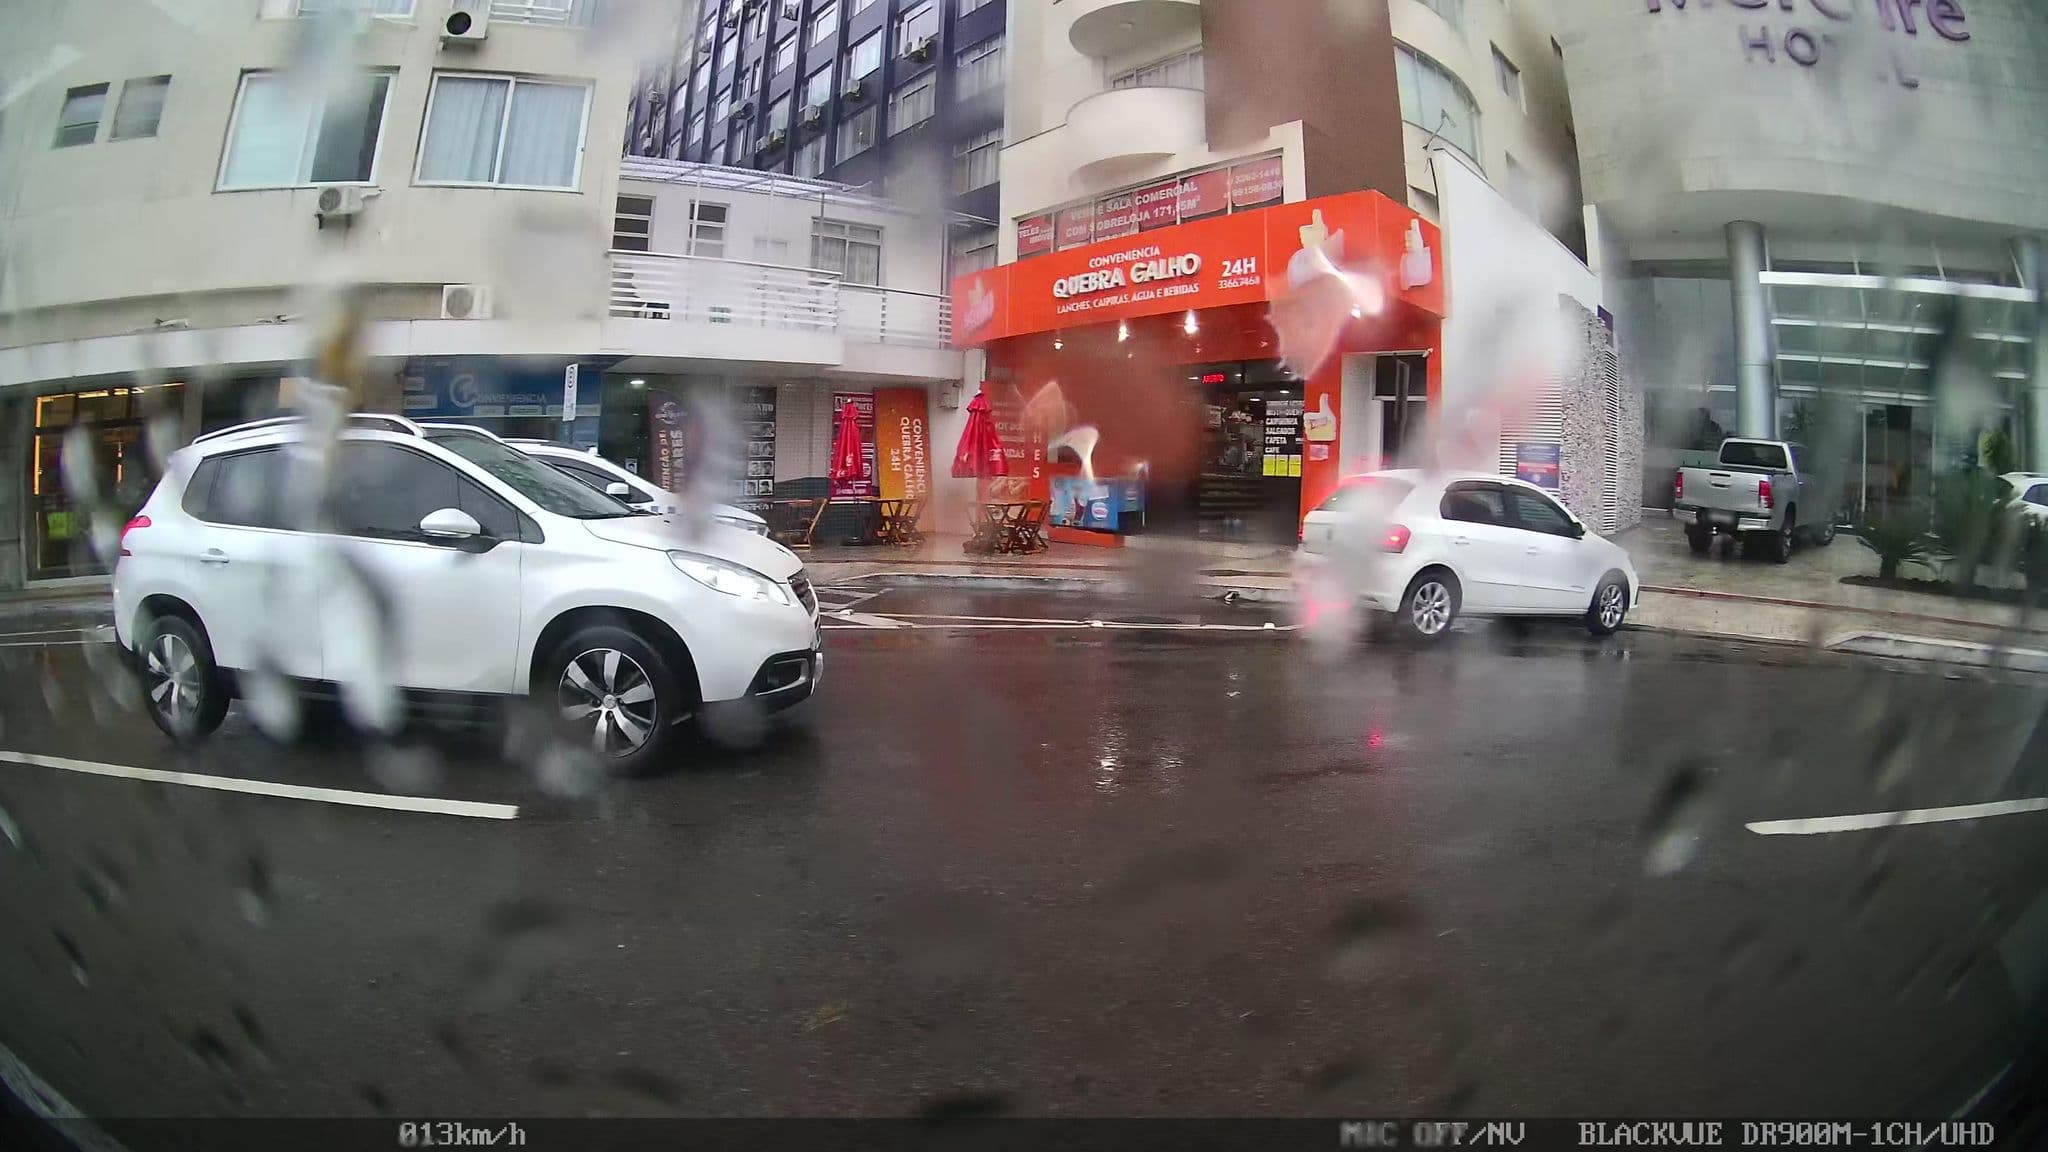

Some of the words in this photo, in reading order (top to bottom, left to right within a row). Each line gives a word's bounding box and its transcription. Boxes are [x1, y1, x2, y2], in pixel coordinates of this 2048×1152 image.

[1106, 198, 1131, 212] SALA
[1066, 225, 1087, 238] COM
[1089, 210, 1150, 231] SOBRELOJA
[1089, 246, 1160, 268] CONVENIENCIA
[1221, 256, 1256, 277] 24H
[1053, 267, 1126, 298] QUEBRA
[1130, 253, 1201, 284] GALHO
[1156, 288, 1162, 298] E
[1163, 283, 1199, 297] BEBIDAS
[900, 416, 912, 461] QUEBRA
[891, 449, 901, 471] 24H
